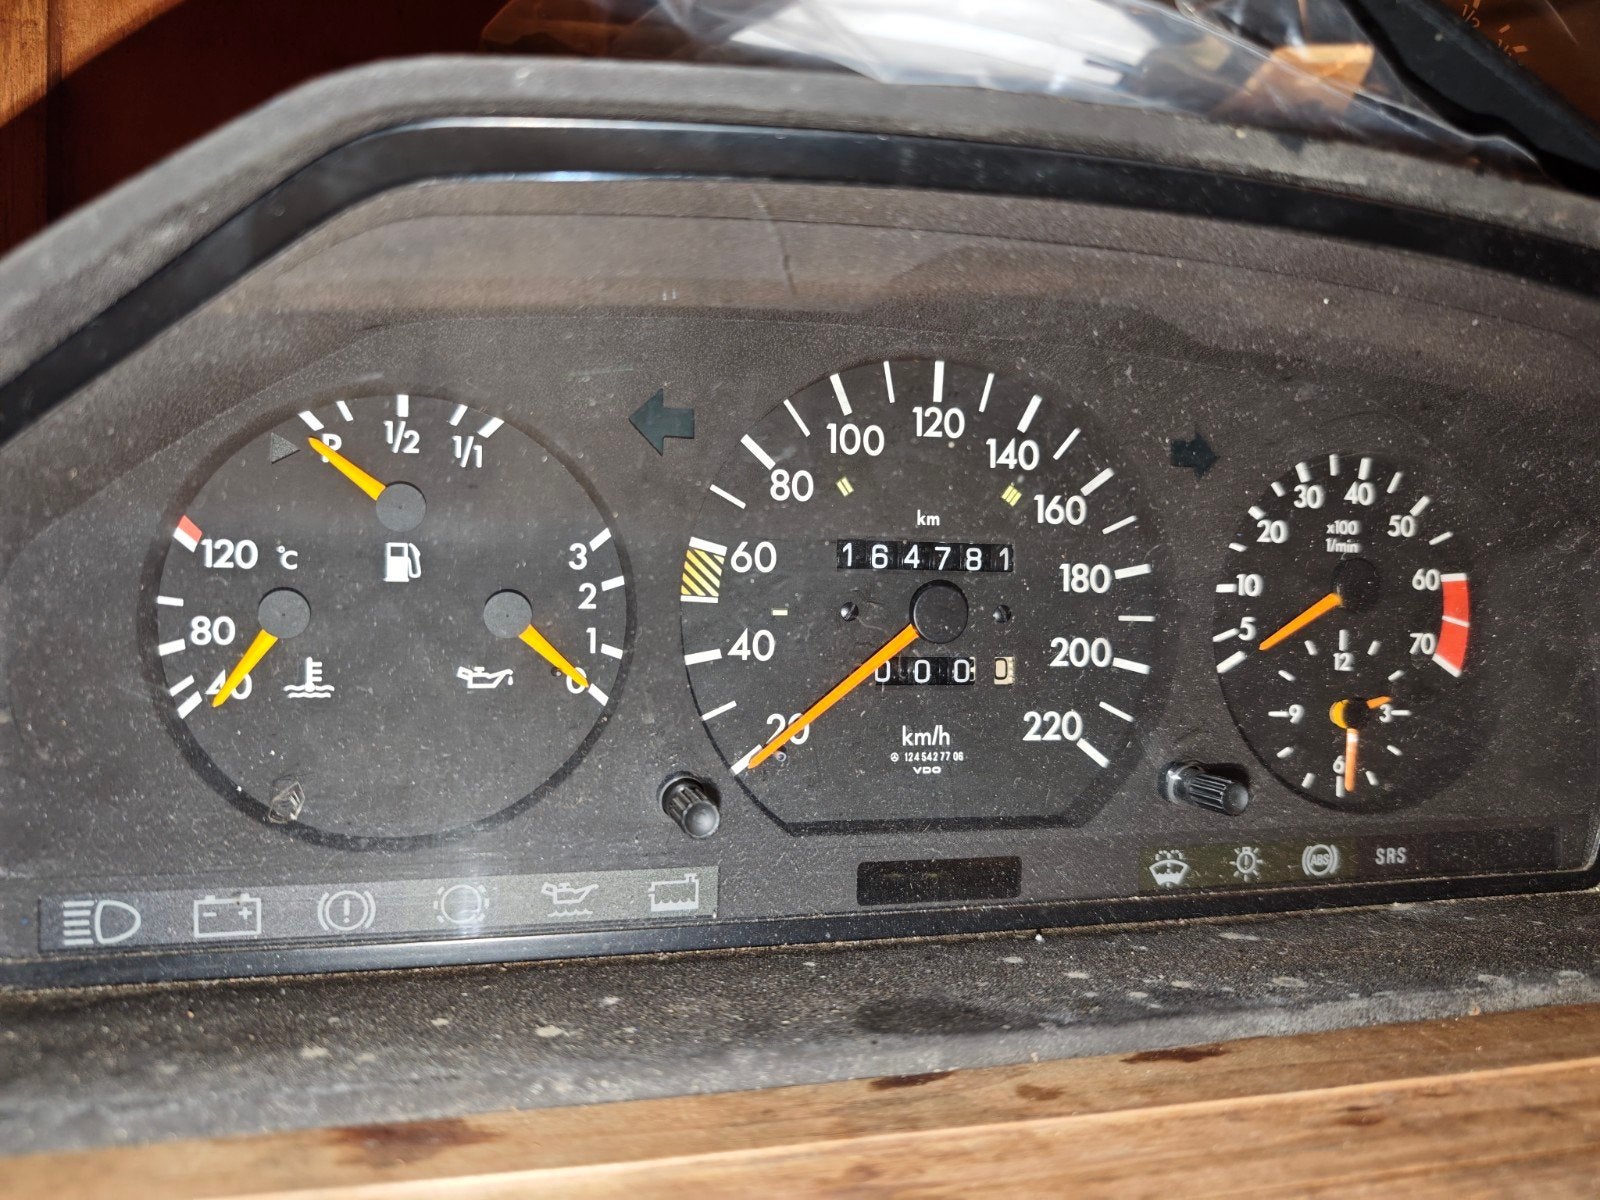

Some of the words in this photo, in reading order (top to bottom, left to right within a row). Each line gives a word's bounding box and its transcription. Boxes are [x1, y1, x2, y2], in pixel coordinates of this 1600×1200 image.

[912, 406, 965, 439] 120
[384, 420, 420, 453] 1/2
[826, 423, 885, 456] 100
[452, 435, 483, 468] 1/1
[985, 438, 1040, 471] 140
[770, 468, 814, 502] 80
[1293, 483, 1325, 509] 30
[1344, 481, 1376, 506] 40
[916, 509, 940, 526] km
[1033, 494, 1087, 525] 160
[1256, 519, 1288, 544] 20
[1326, 519, 1361, 535] x100
[1387, 514, 1418, 538] 50
[200, 538, 258, 569] 120
[276, 545, 298, 570] °C
[568, 542, 588, 571] 3
[730, 541, 777, 573] 60
[842, 542, 1009, 571] 164781
[1059, 562, 1112, 594] 180
[1235, 573, 1263, 597] 10
[1411, 568, 1441, 591] 60
[578, 582, 597, 610] 2
[190, 615, 236, 646] 80
[585, 627, 597, 654] 1
[1238, 616, 1256, 641] 5
[727, 628, 776, 661] 40
[1049, 637, 1112, 668] 200
[1409, 632, 1437, 655] 70
[1333, 652, 1355, 671] 12
[204, 669, 253, 700] 40
[1022, 710, 1084, 742] 220
[1288, 704, 1305, 724] 9
[1378, 703, 1393, 723] 3
[766, 712, 810, 745] 20
[902, 724, 951, 746] km/h
[912, 765, 942, 775] VDO
[1332, 755, 1346, 775] 6
[1310, 853, 1330, 867] ABS
[1375, 846, 1407, 865] SRS
